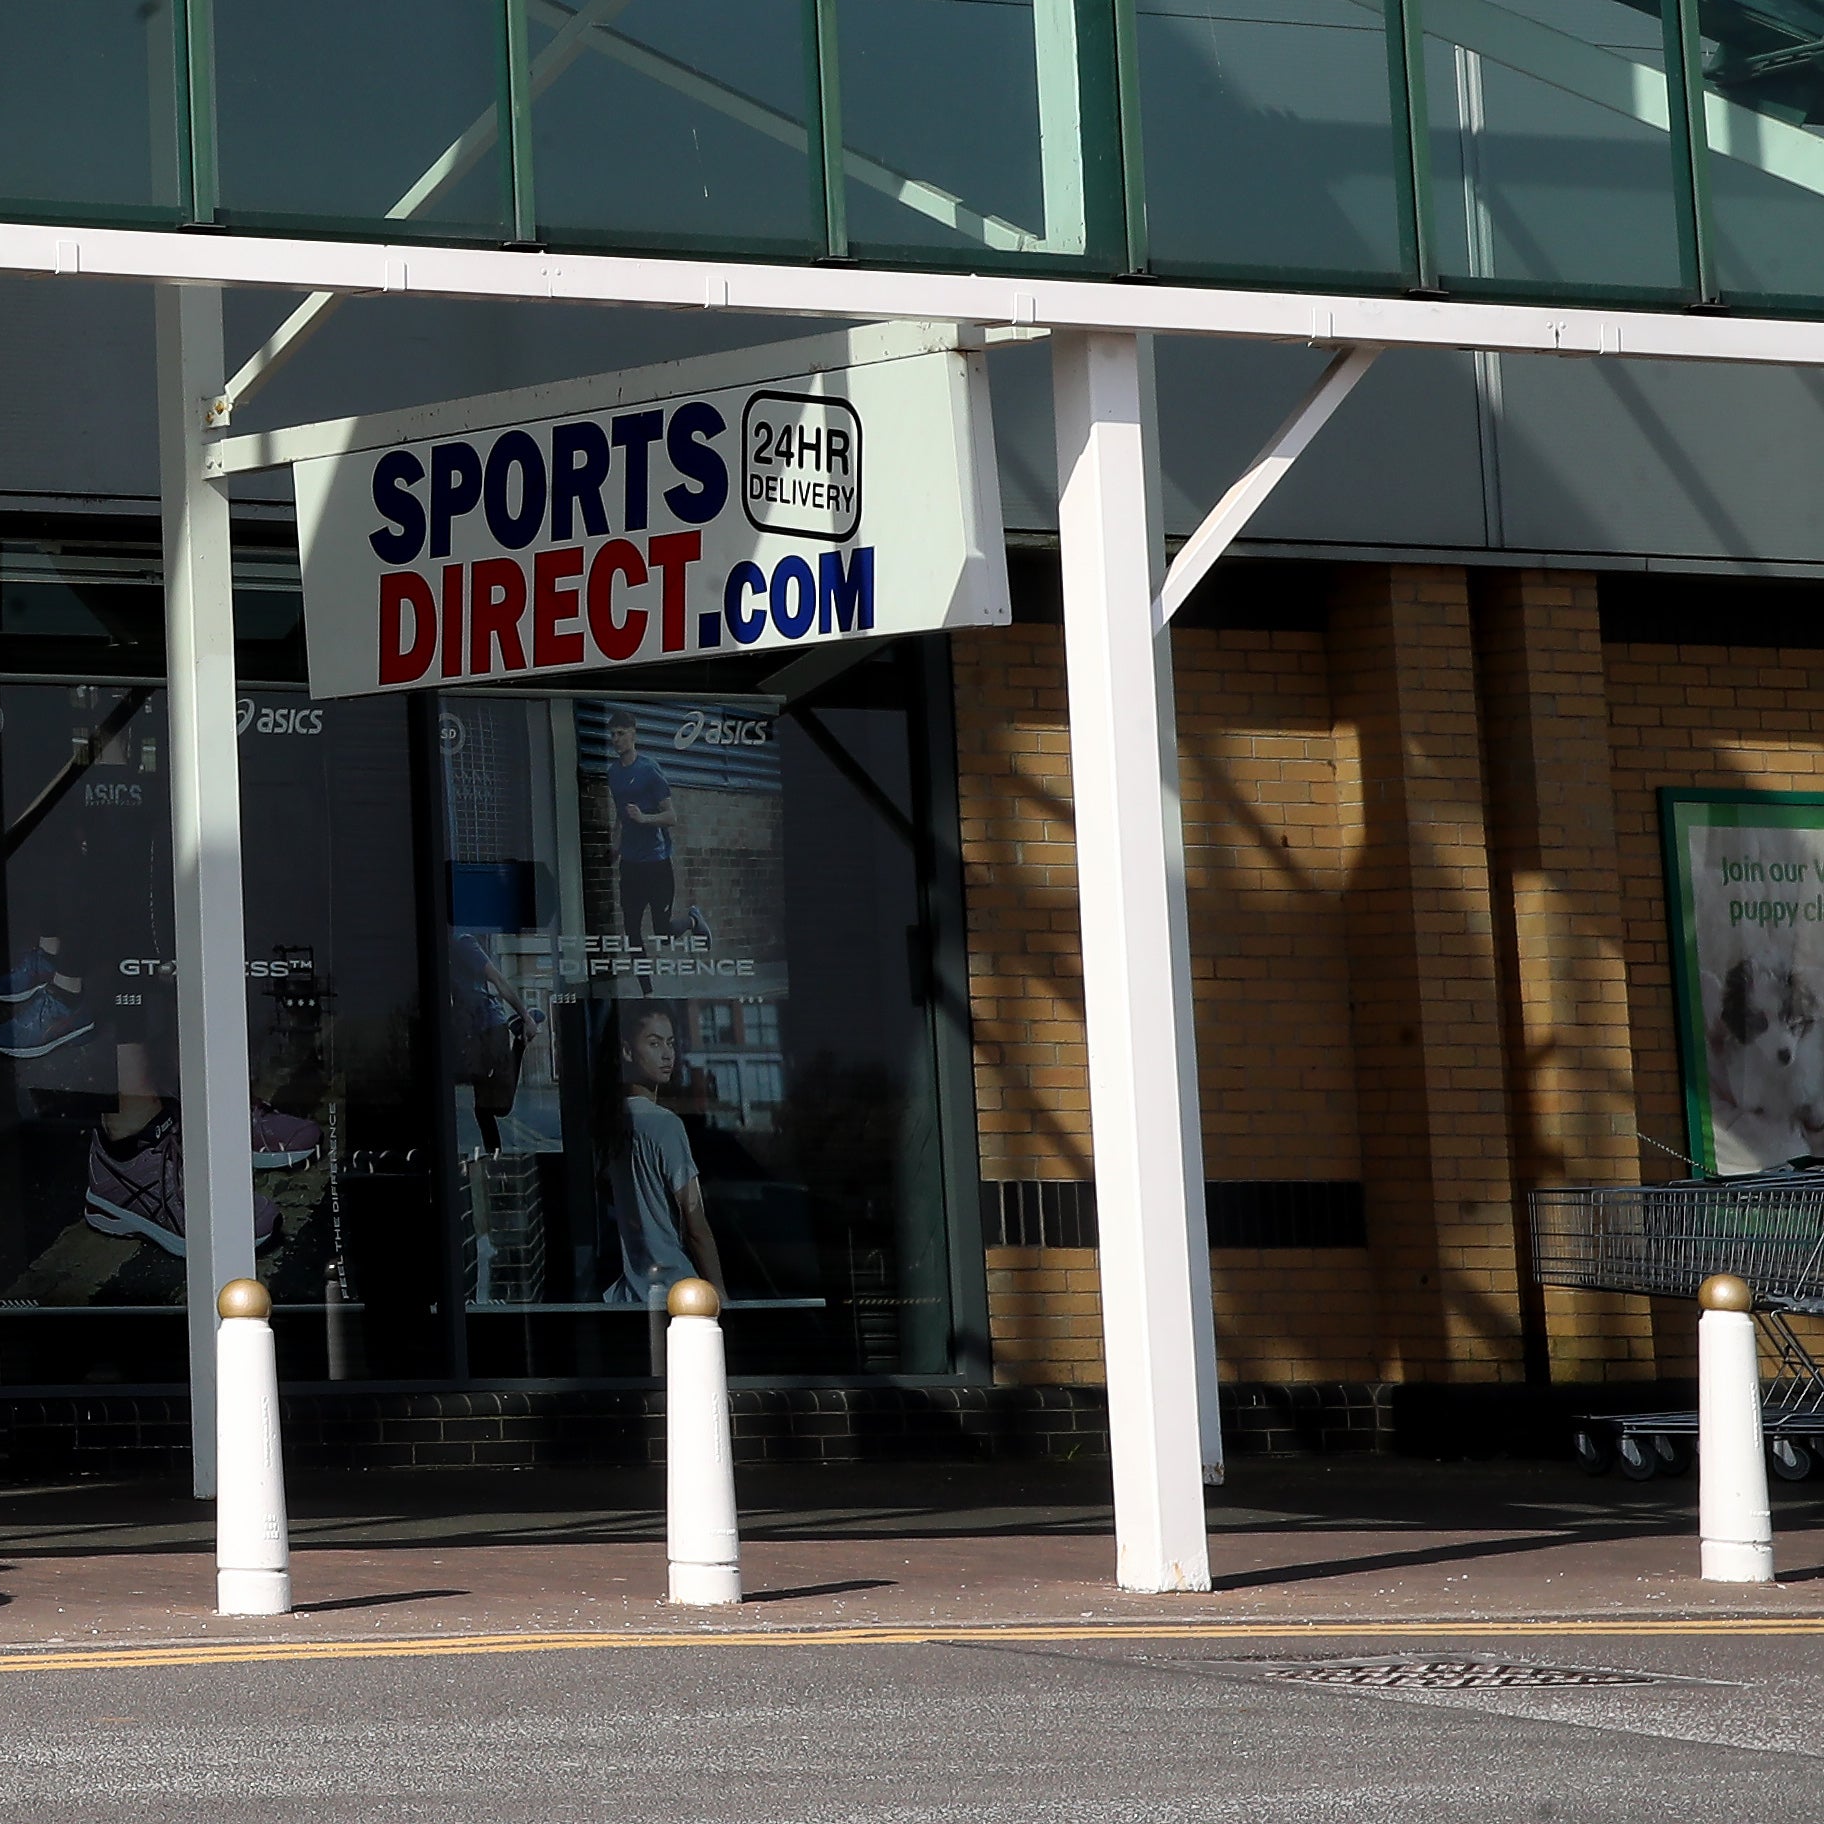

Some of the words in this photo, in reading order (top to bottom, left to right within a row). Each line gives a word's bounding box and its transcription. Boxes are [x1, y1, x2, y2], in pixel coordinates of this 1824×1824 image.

[753, 421, 850, 476] 24HR
[369, 401, 729, 565] SPORTS
[749, 474, 855, 515] DELIVERY
[1721, 855, 1764, 886] Join
[1769, 863, 1807, 882] our
[1729, 901, 1798, 928] puppy
[557, 935, 644, 953] FEEL
[648, 935, 710, 952] THE
[559, 959, 755, 976] DIFFERENCE
[334, 1216, 343, 1252] THE
